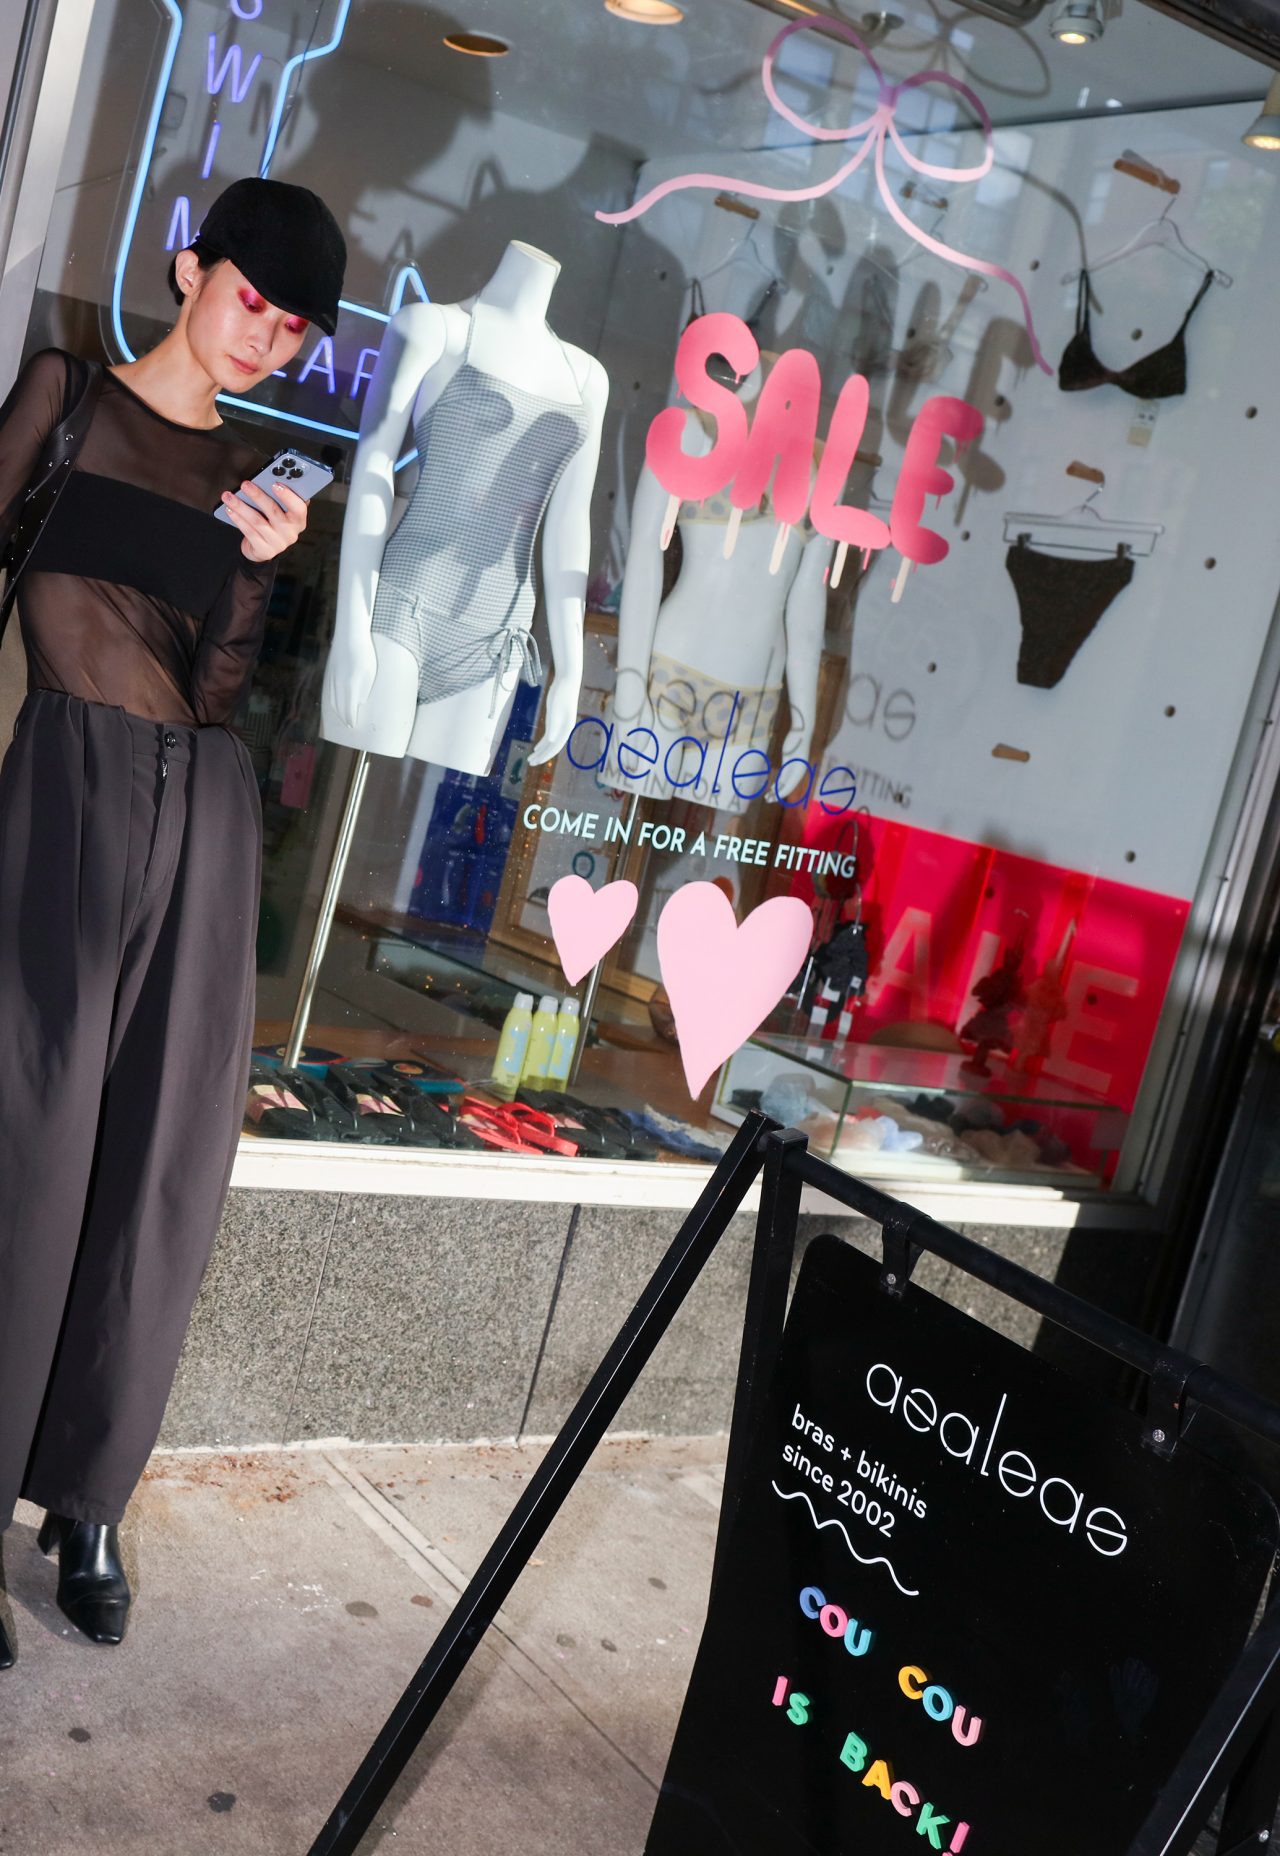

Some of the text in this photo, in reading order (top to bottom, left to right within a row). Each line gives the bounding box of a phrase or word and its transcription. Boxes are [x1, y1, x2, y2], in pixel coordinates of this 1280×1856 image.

[645, 312, 984, 566] SALE
[566, 690, 857, 815] aealeas
[522, 803, 857, 879] COME IN FOR A FREE FITTING
[782, 1441, 897, 1538] since 2002
[791, 1403, 928, 1519] bras + bikinis
[866, 1363, 1128, 1556] aealeas
[799, 1586, 983, 1747] COU COU
[771, 1675, 970, 1856] IS BACK!
